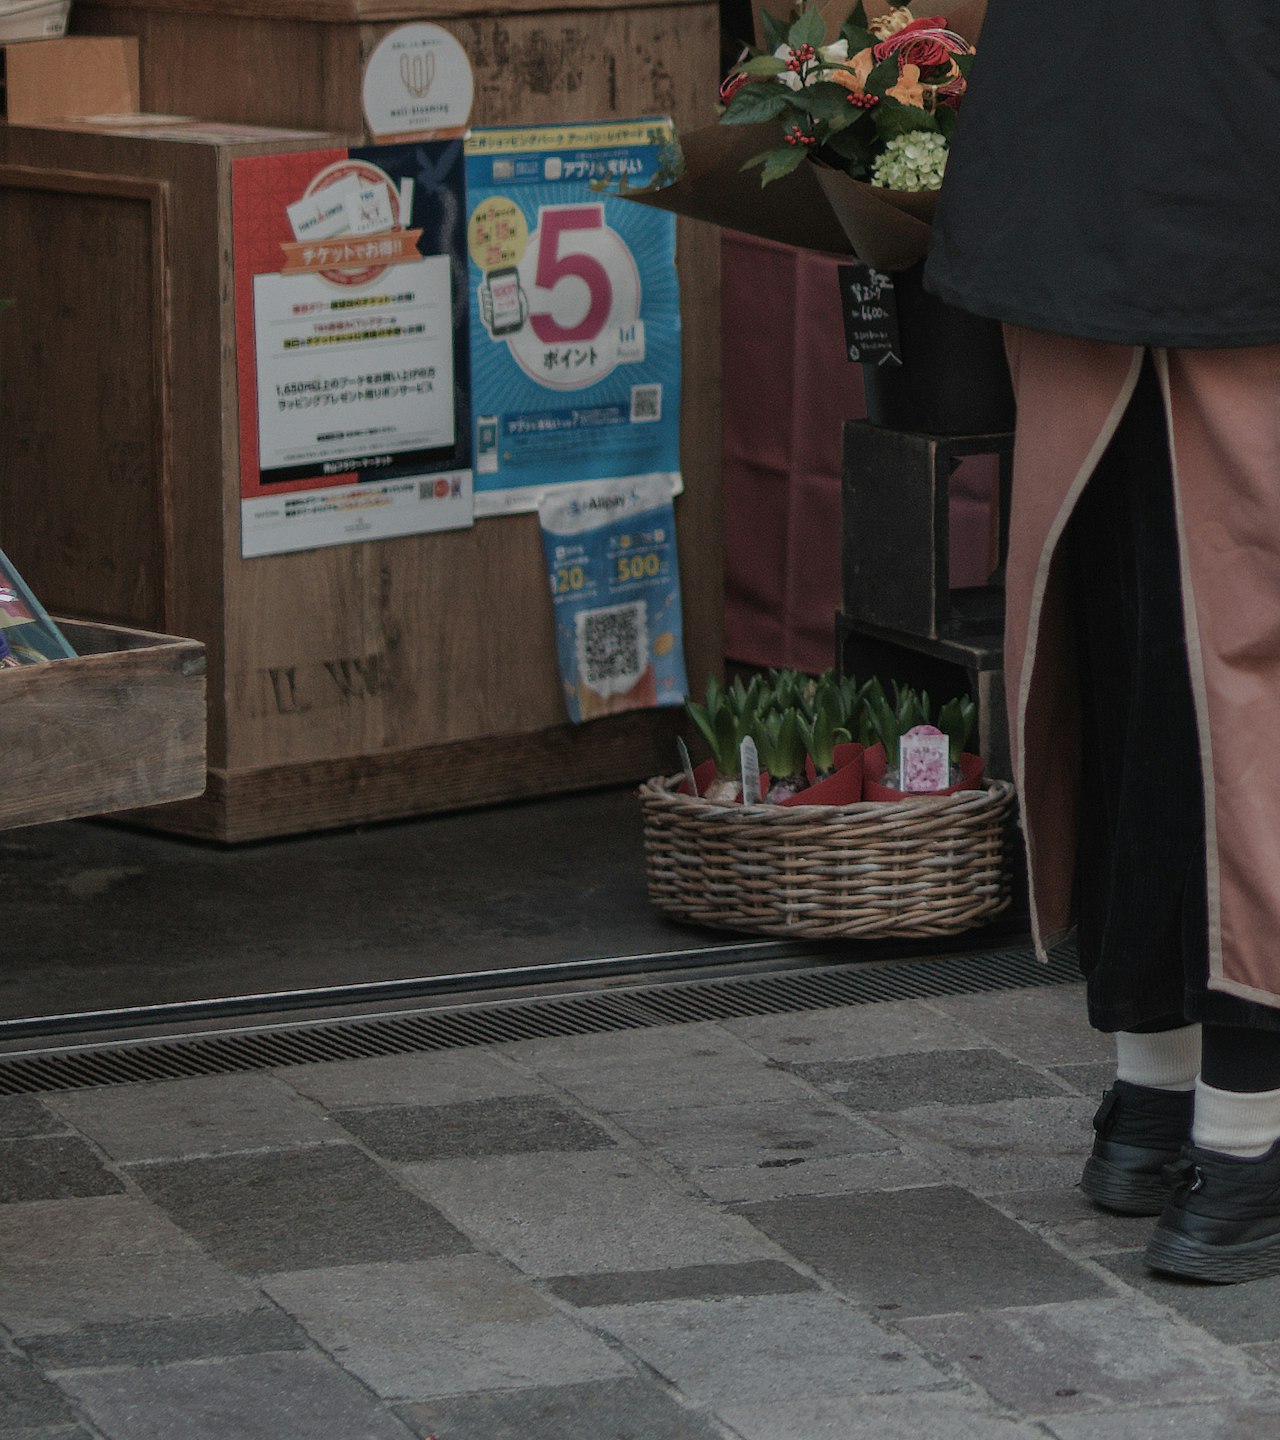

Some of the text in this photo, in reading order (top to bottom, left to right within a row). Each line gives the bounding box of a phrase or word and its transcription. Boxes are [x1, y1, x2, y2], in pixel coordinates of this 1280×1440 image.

[529, 207, 614, 344] 5
[543, 346, 598, 370] ポイント
